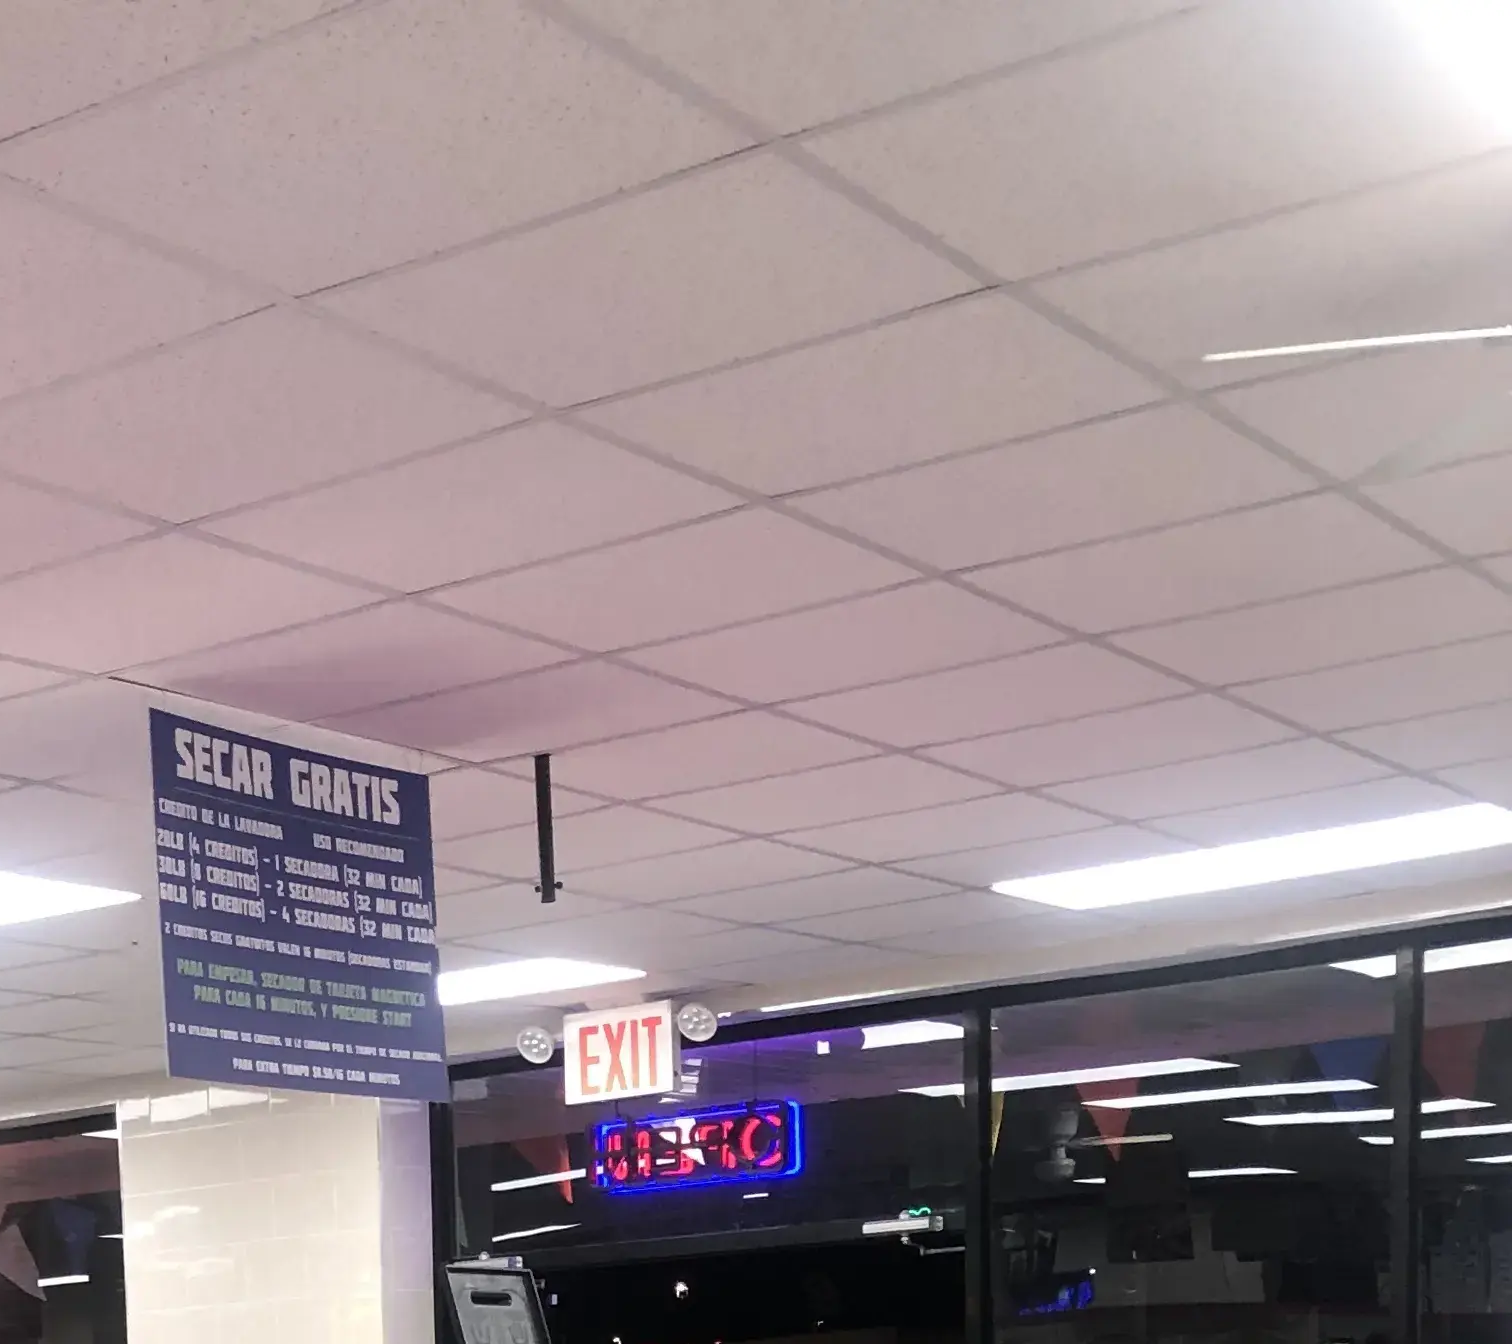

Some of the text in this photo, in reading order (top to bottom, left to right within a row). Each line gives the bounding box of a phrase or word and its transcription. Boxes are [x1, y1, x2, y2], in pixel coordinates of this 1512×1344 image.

[174, 728, 399, 824] SECAR GRATIS
[218, 812, 230, 829] LA
[579, 1016, 662, 1095] EXIT
